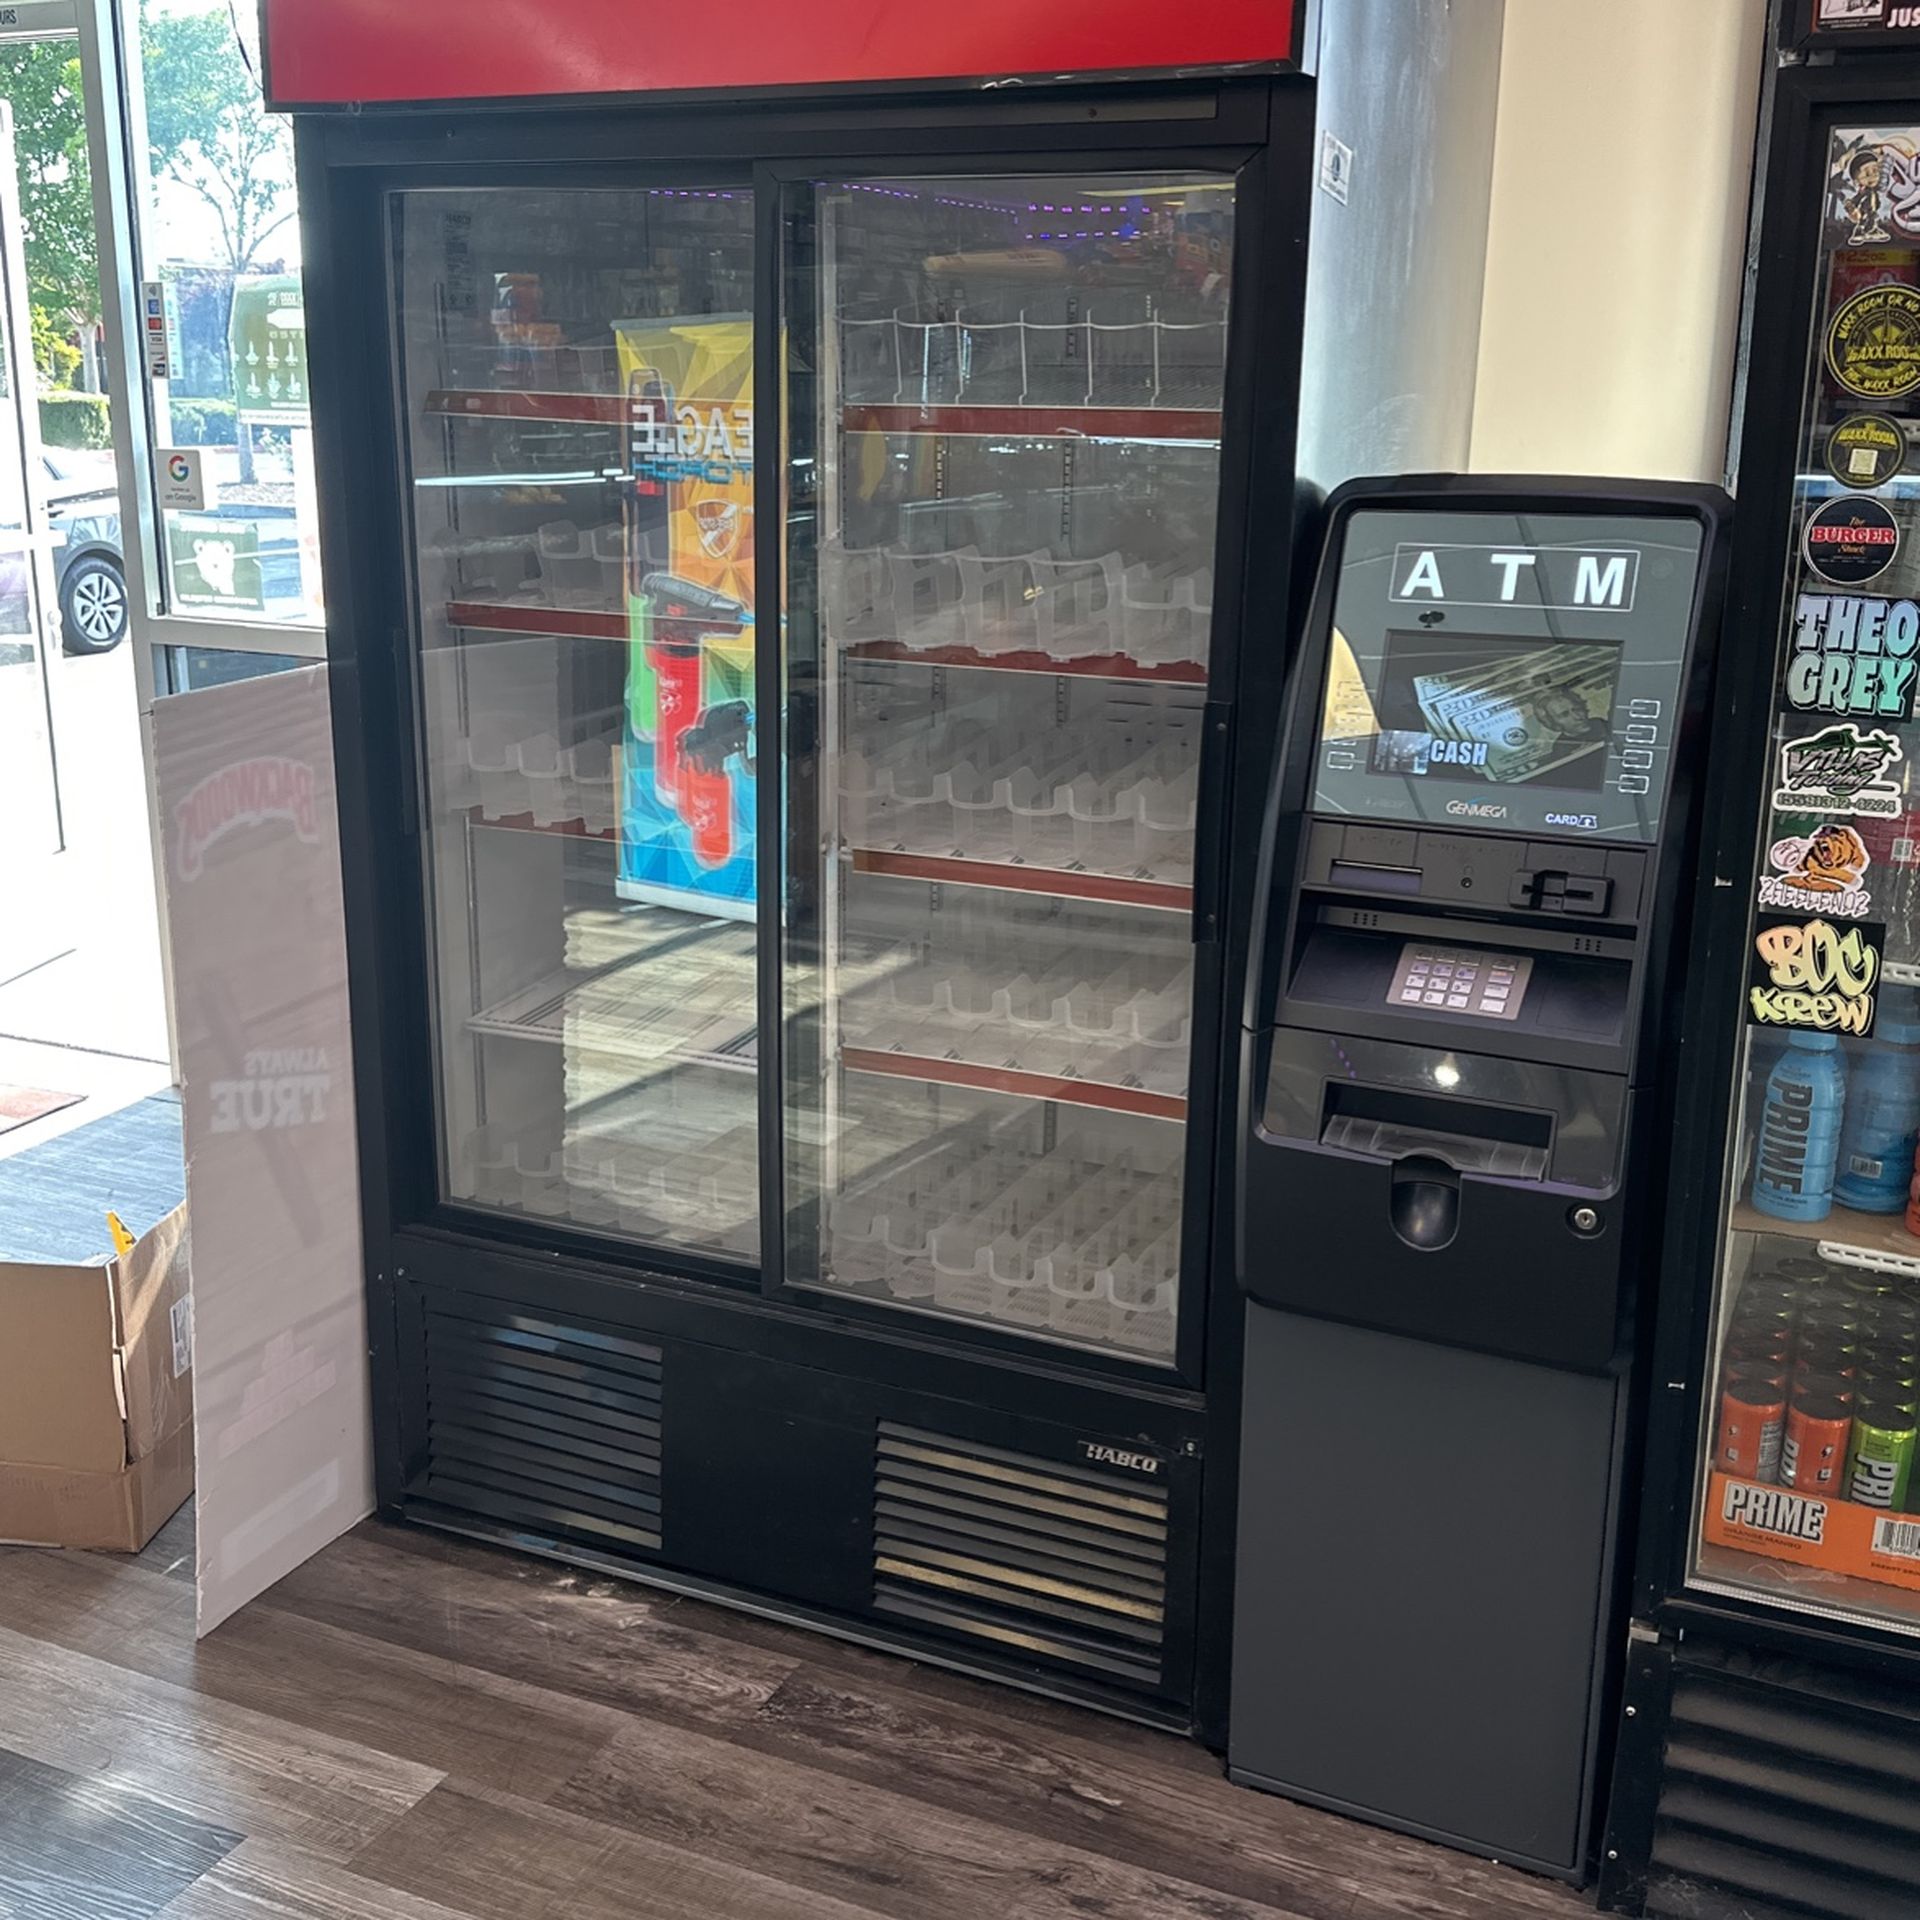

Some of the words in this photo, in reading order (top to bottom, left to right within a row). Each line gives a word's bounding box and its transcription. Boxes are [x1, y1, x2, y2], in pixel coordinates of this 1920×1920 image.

[1887, 294, 1904, 306] OR
[1811, 526, 1895, 544] BURGER
[1401, 551, 1628, 606] ATM
[1797, 594, 1919, 658] THEO
[1788, 653, 1916, 714] GREY
[1430, 739, 1488, 766] CASH
[1446, 799, 1507, 819] GENMEGA
[1545, 813, 1579, 826] CARD
[1755, 919, 1878, 998] BOC
[1758, 1076, 1814, 1196] PRIME
[1086, 1443, 1159, 1475] HABCO
[1724, 1481, 1826, 1544] PRIME
